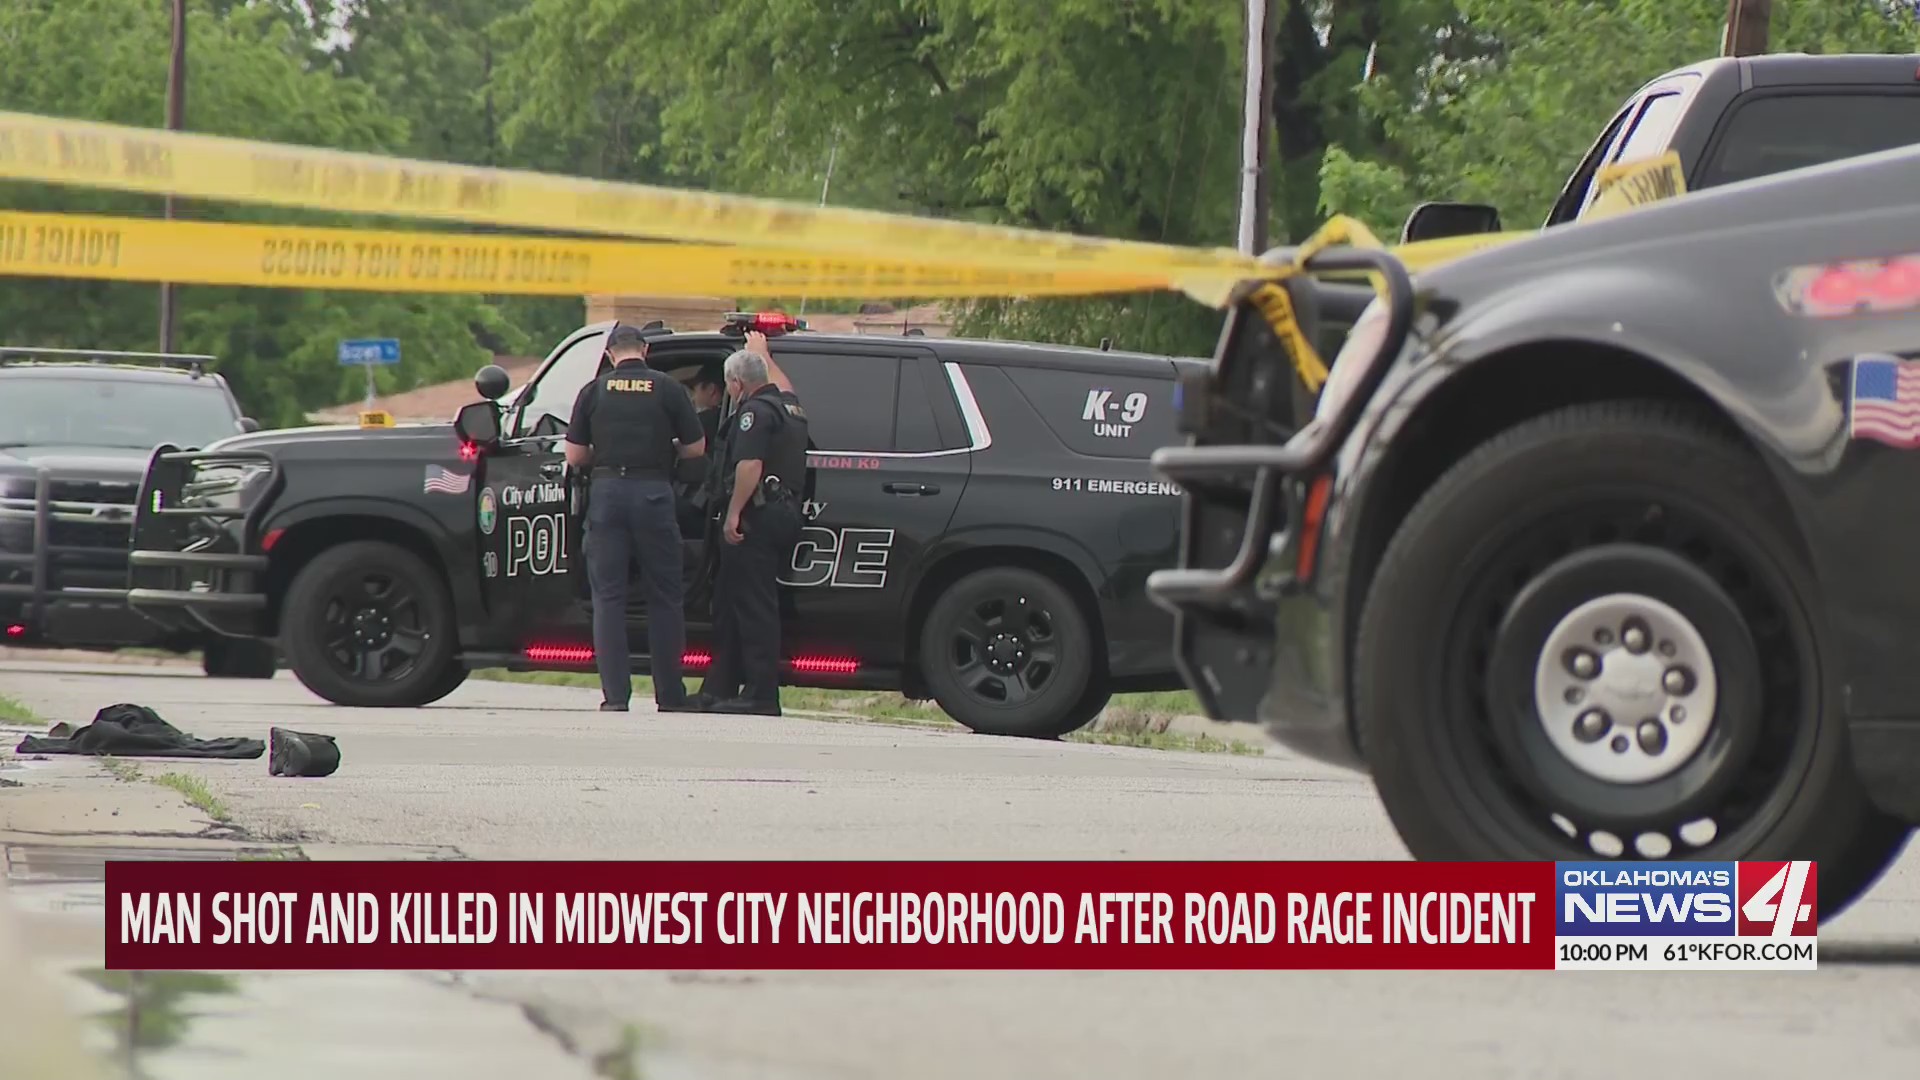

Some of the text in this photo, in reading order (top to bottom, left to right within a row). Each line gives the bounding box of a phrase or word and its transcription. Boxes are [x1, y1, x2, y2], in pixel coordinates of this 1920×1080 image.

[606, 379, 654, 393] POLICE
[1082, 389, 1148, 423] K-9
[1093, 423, 1132, 437] UNIT
[858, 458, 881, 469] K9
[1052, 477, 1082, 490] 911
[502, 485, 524, 510] City
[524, 484, 537, 504] of
[507, 513, 568, 577] POL
